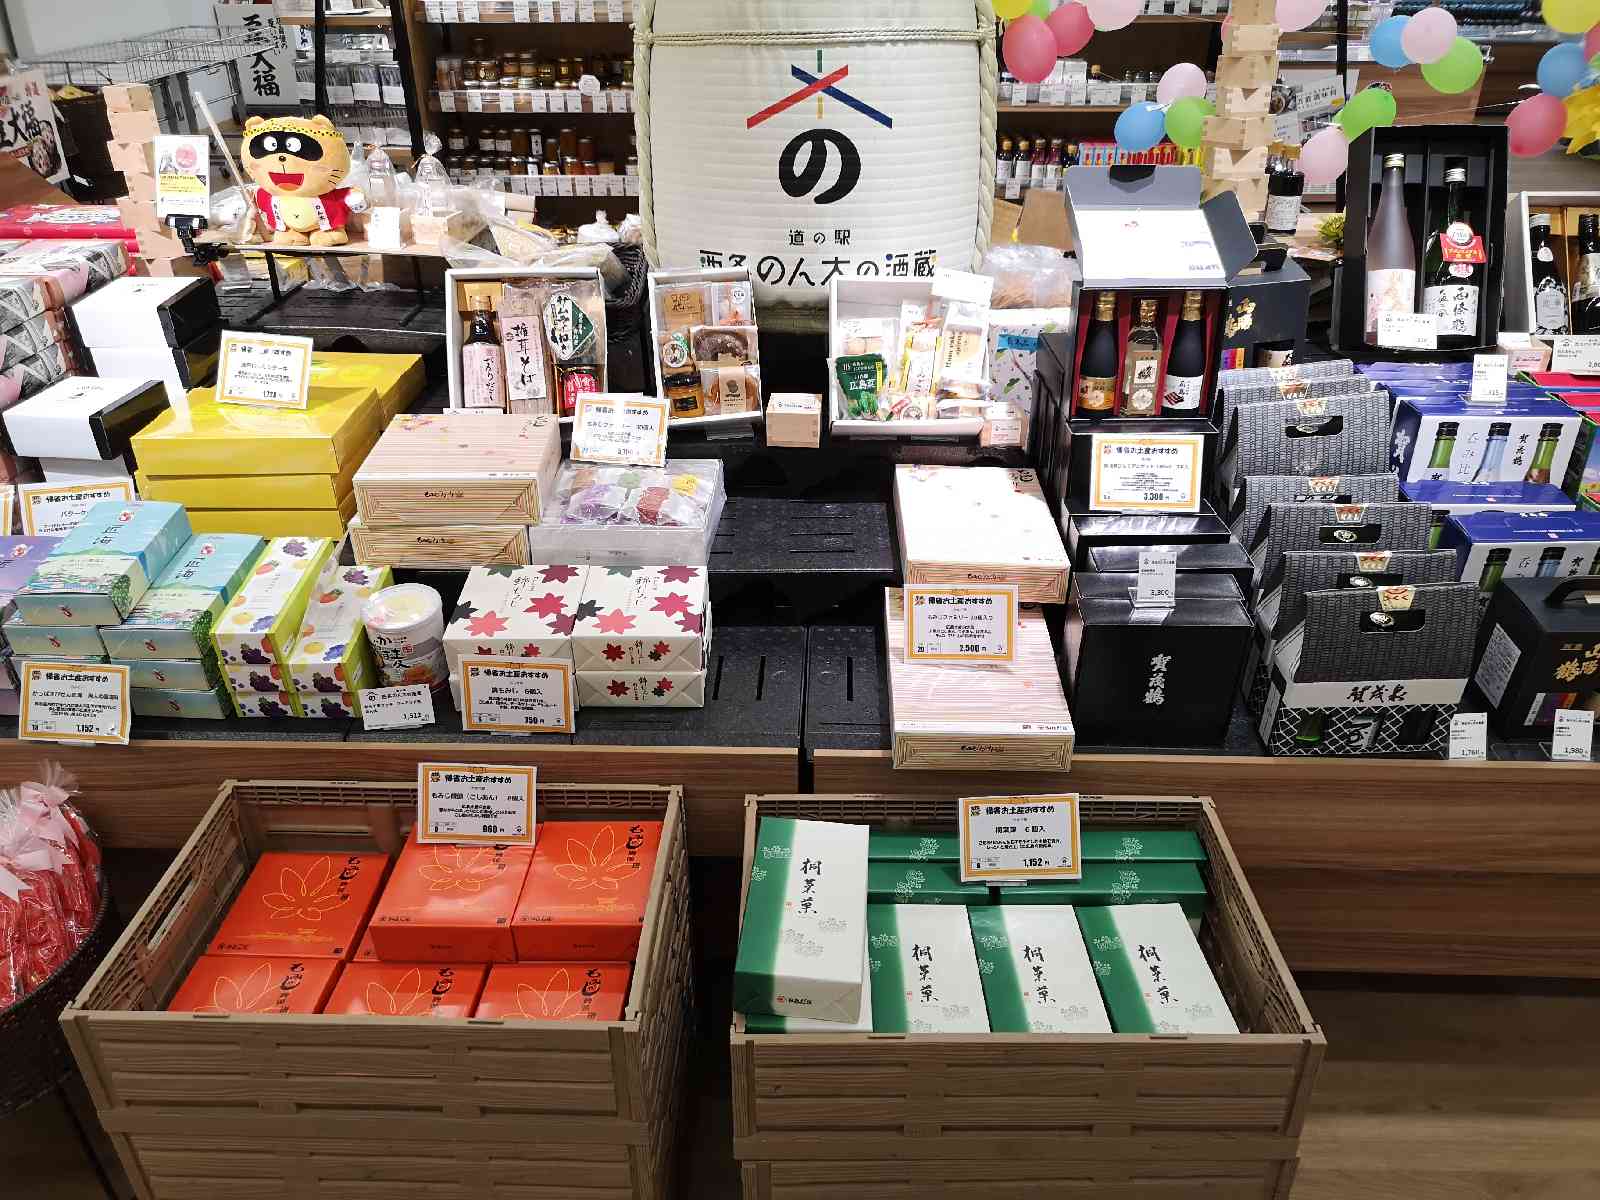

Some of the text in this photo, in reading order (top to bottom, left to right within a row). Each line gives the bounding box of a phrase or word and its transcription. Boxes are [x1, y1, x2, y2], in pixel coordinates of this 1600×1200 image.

[779, 129, 862, 204] の
[788, 229, 851, 245] 道の駅
[1142, 653, 1172, 705] 賀茂鶴
[1023, 857, 1044, 869] 1,152
